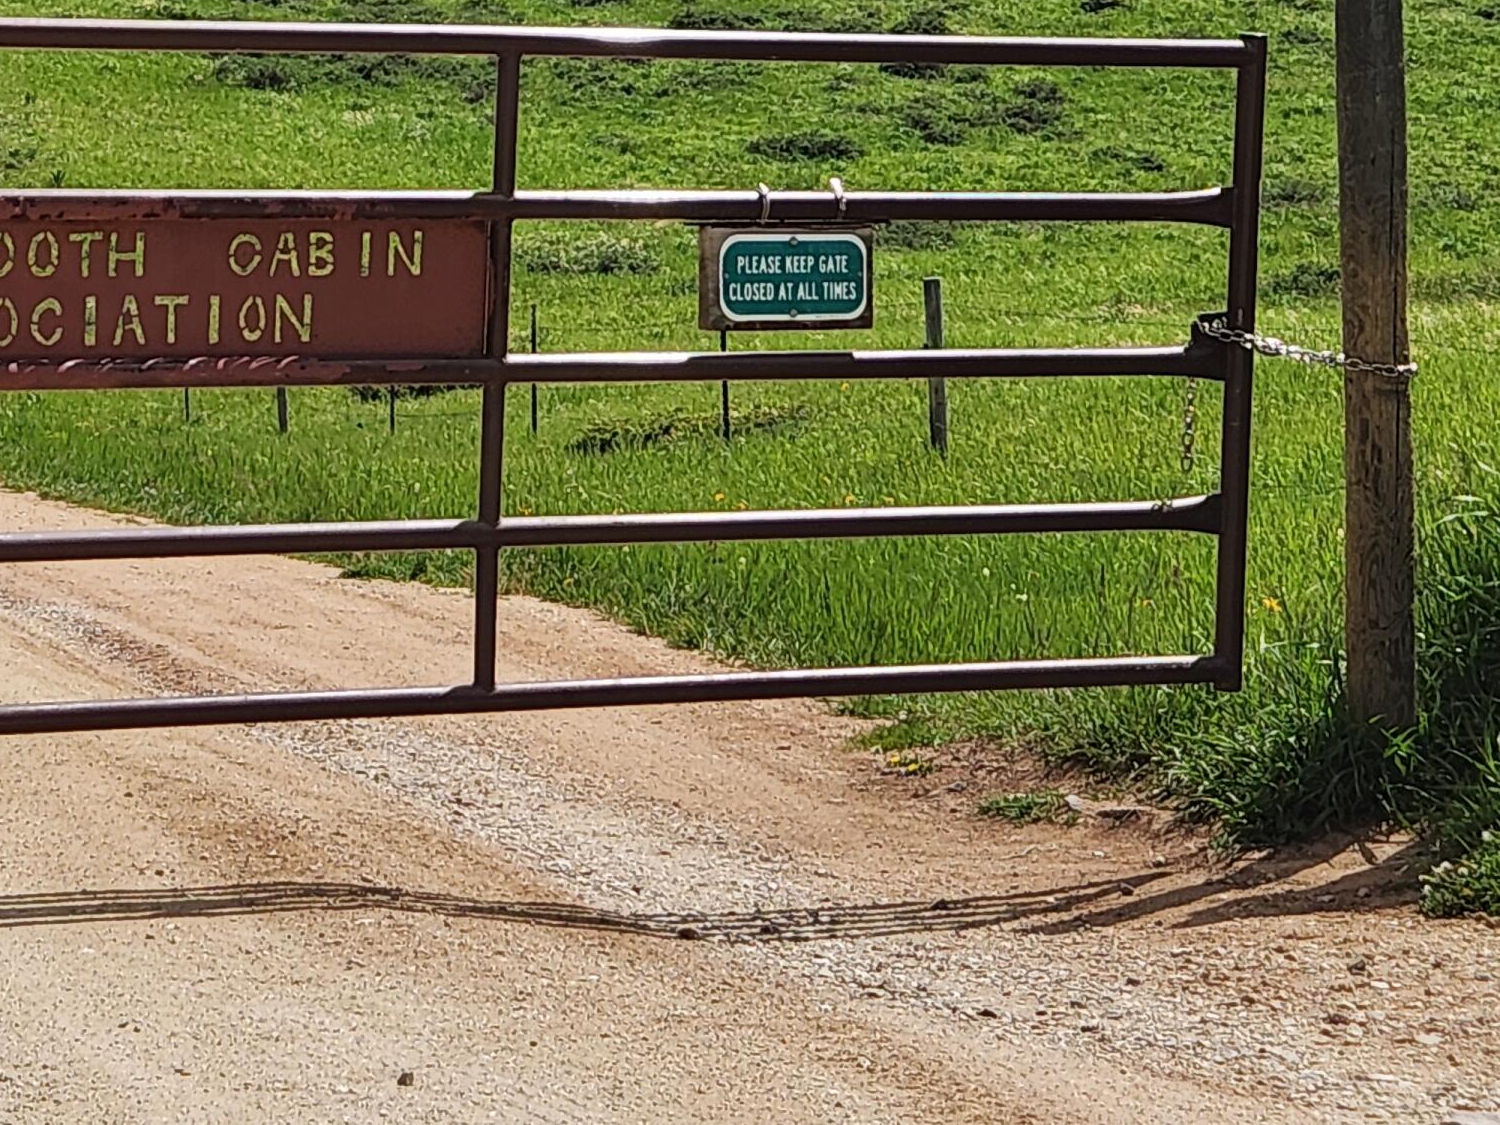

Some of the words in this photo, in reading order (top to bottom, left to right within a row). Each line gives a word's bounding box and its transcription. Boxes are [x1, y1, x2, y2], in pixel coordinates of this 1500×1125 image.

[228, 230, 424, 277] CABIN
[736, 255, 782, 274] PLEASE
[785, 255, 815, 274] KEEP
[818, 255, 849, 274] GATE
[728, 282, 775, 301] CLOSED
[778, 282, 794, 301] AT
[797, 282, 819, 301] ALL
[822, 281, 857, 300] TIMES
